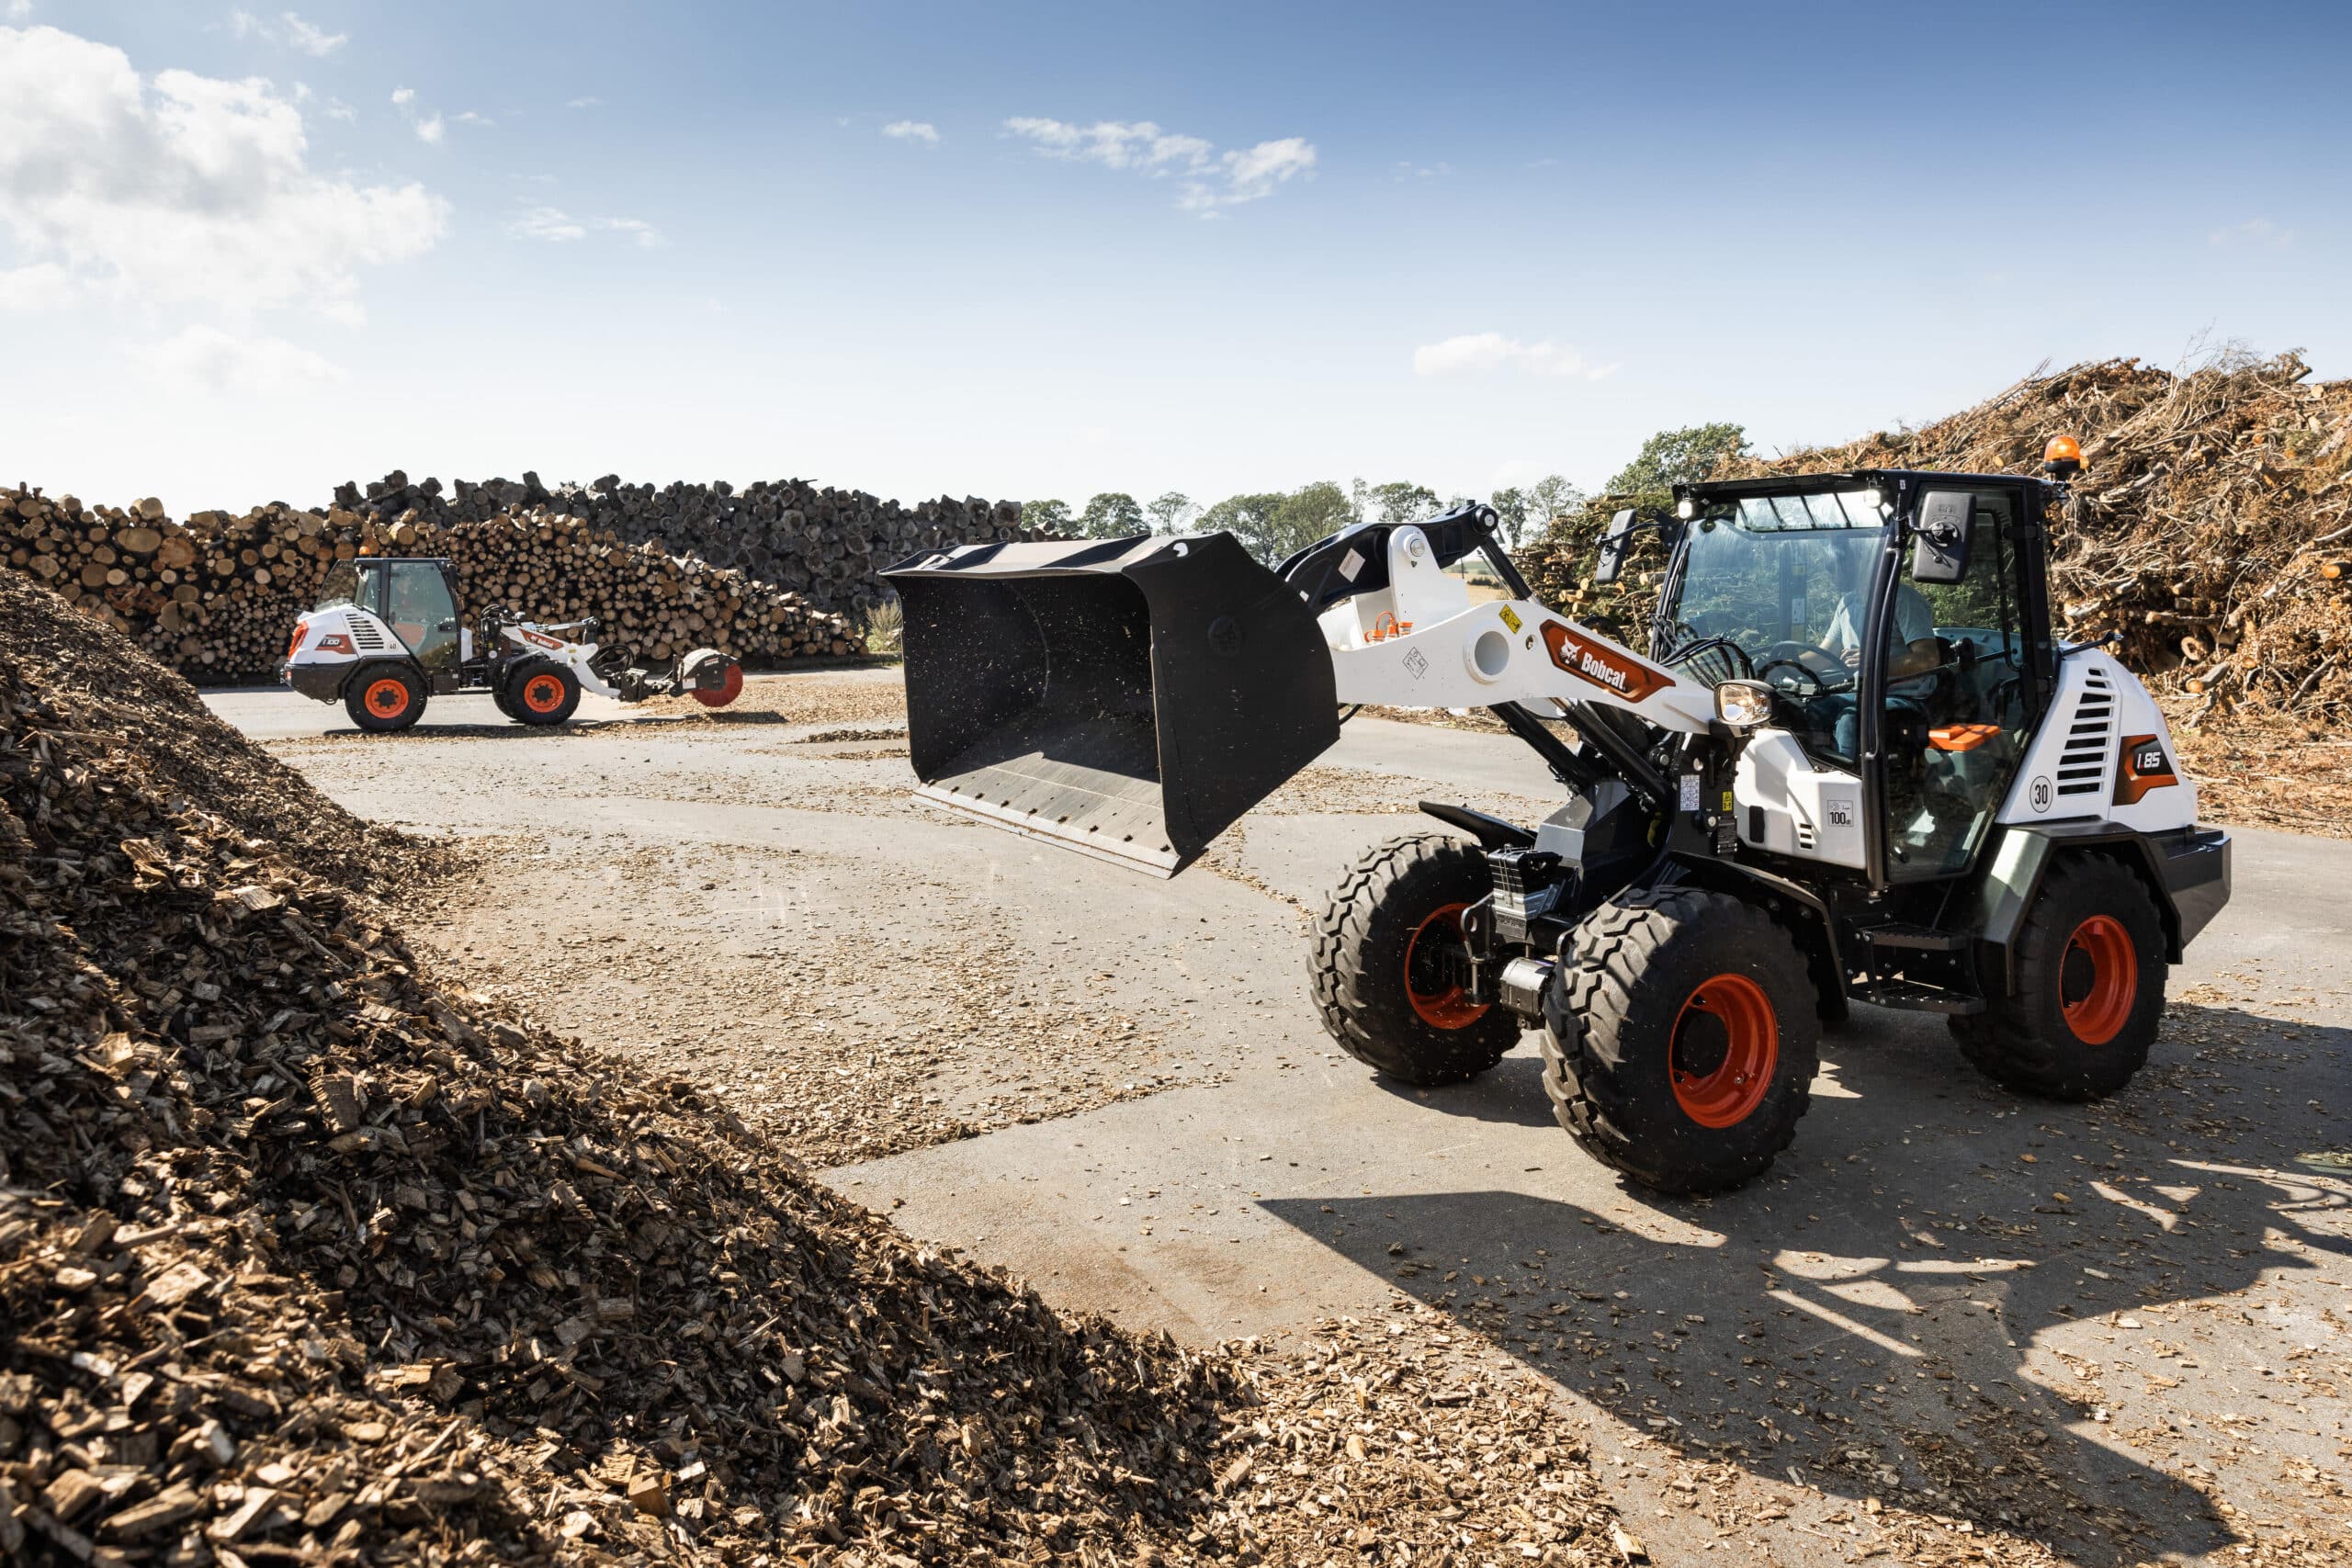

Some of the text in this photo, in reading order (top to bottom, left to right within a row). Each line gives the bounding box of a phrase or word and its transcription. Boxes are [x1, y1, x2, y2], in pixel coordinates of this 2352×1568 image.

[1581, 651, 1626, 690] Bobcat
[2034, 784, 2048, 805] 30
[1829, 811, 1846, 825] 100
